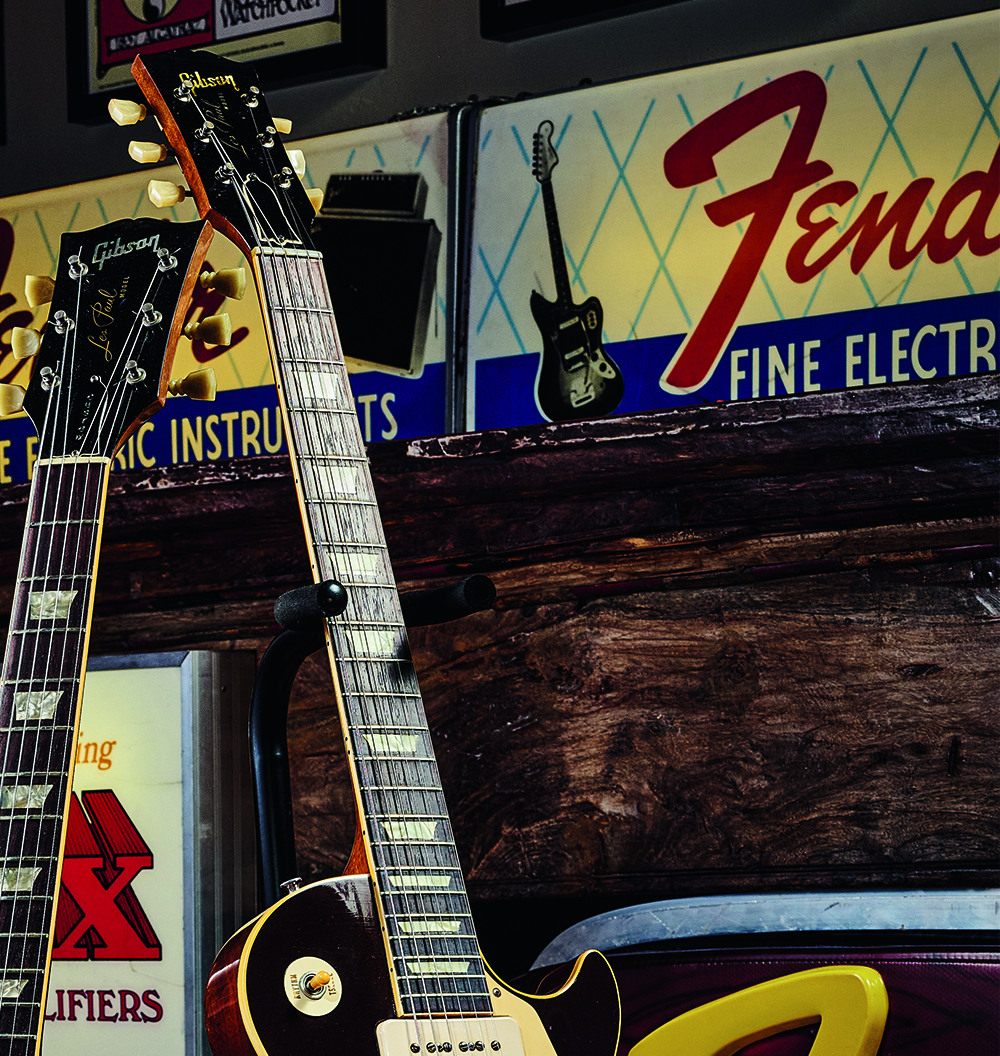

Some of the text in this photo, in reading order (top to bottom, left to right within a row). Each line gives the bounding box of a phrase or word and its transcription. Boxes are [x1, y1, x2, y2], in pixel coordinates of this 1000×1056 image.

[178, 71, 240, 97] Gibson
[91, 233, 161, 271] Gibson
[119, 275, 130, 299] MODEL
[87, 288, 118, 362] Les Paul
[730, 318, 997, 400] FINE ELECTR
[170, 392, 398, 465] INSTRUTS
